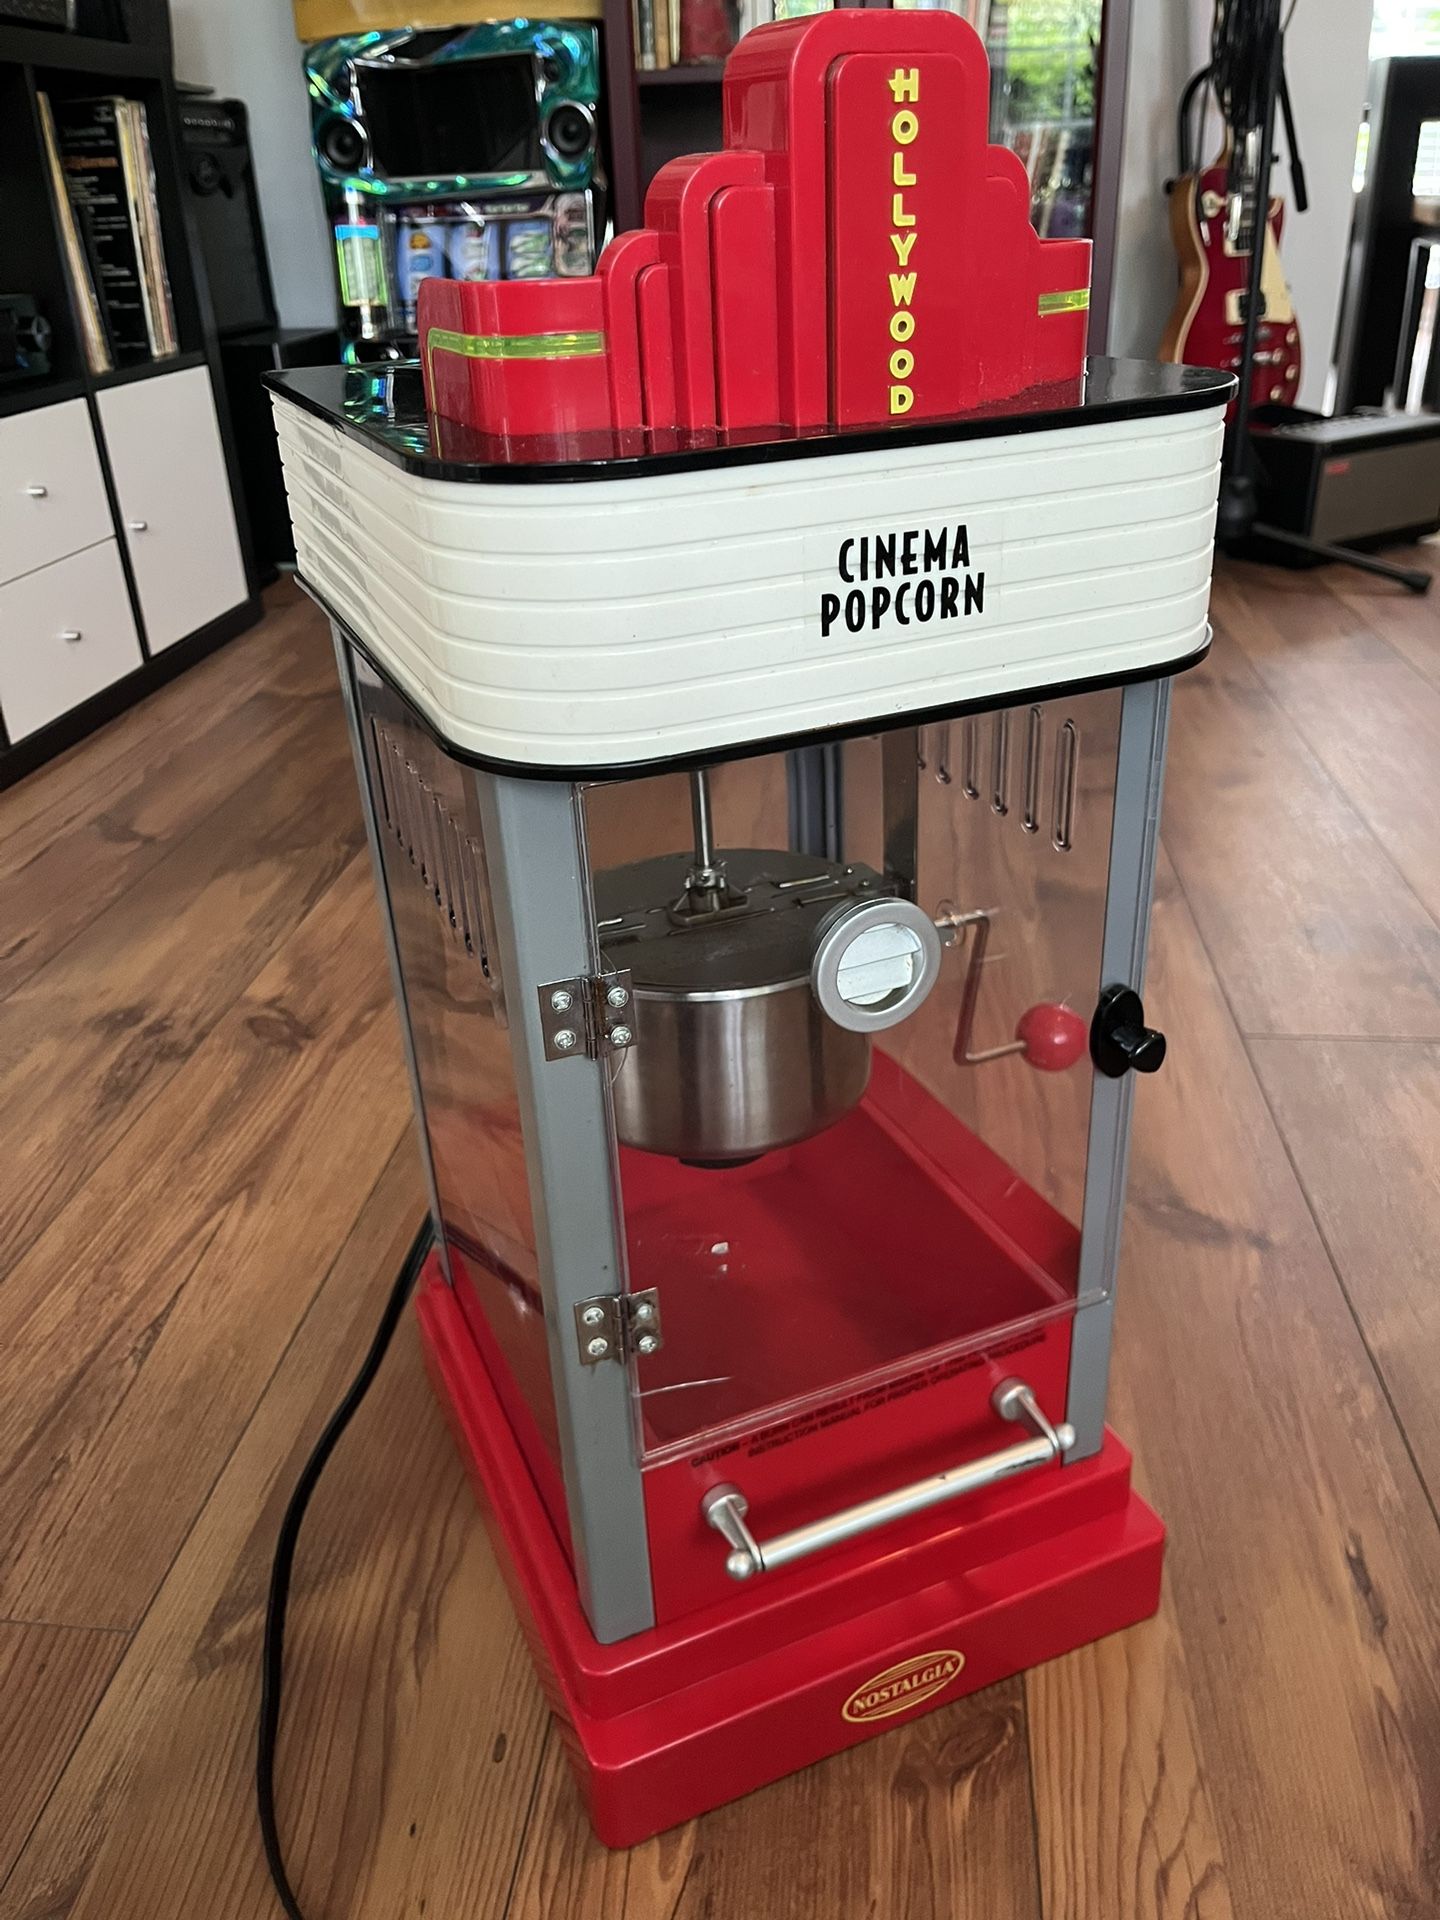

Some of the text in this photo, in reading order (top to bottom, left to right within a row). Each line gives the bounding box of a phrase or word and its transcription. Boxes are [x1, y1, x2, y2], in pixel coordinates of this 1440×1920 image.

[889, 68, 920, 415] HOLLYWOOD
[839, 525, 970, 583] CINEMA
[821, 572, 985, 637] POPCORN
[691, 1442, 740, 1467] CAUTION
[748, 1426, 818, 1457] INSTRUCTION
[852, 1660, 955, 1714] NOSTALGIA
